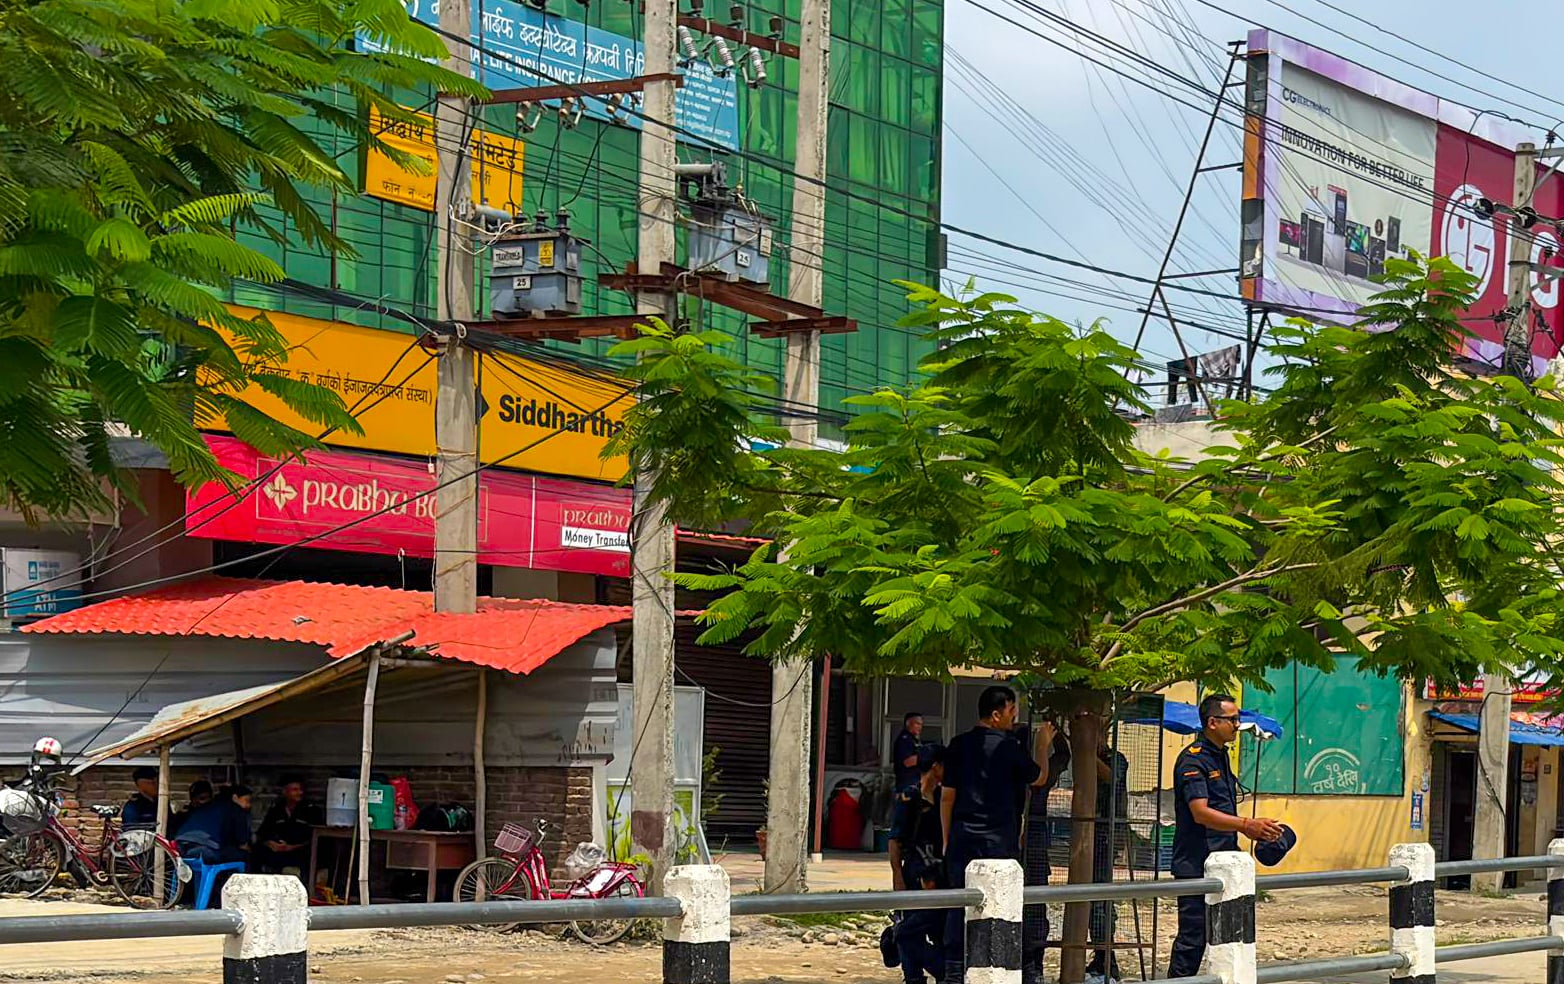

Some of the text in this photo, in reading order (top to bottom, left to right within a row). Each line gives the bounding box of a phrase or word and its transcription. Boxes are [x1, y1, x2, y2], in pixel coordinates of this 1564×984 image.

[1282, 126, 1345, 166] INNOVATION
[1349, 151, 1367, 173] FOR
[1369, 158, 1406, 184] BETTER
[517, 278, 527, 287] 25
[498, 393, 626, 439] Siddhartha
[564, 529, 593, 547] Money
